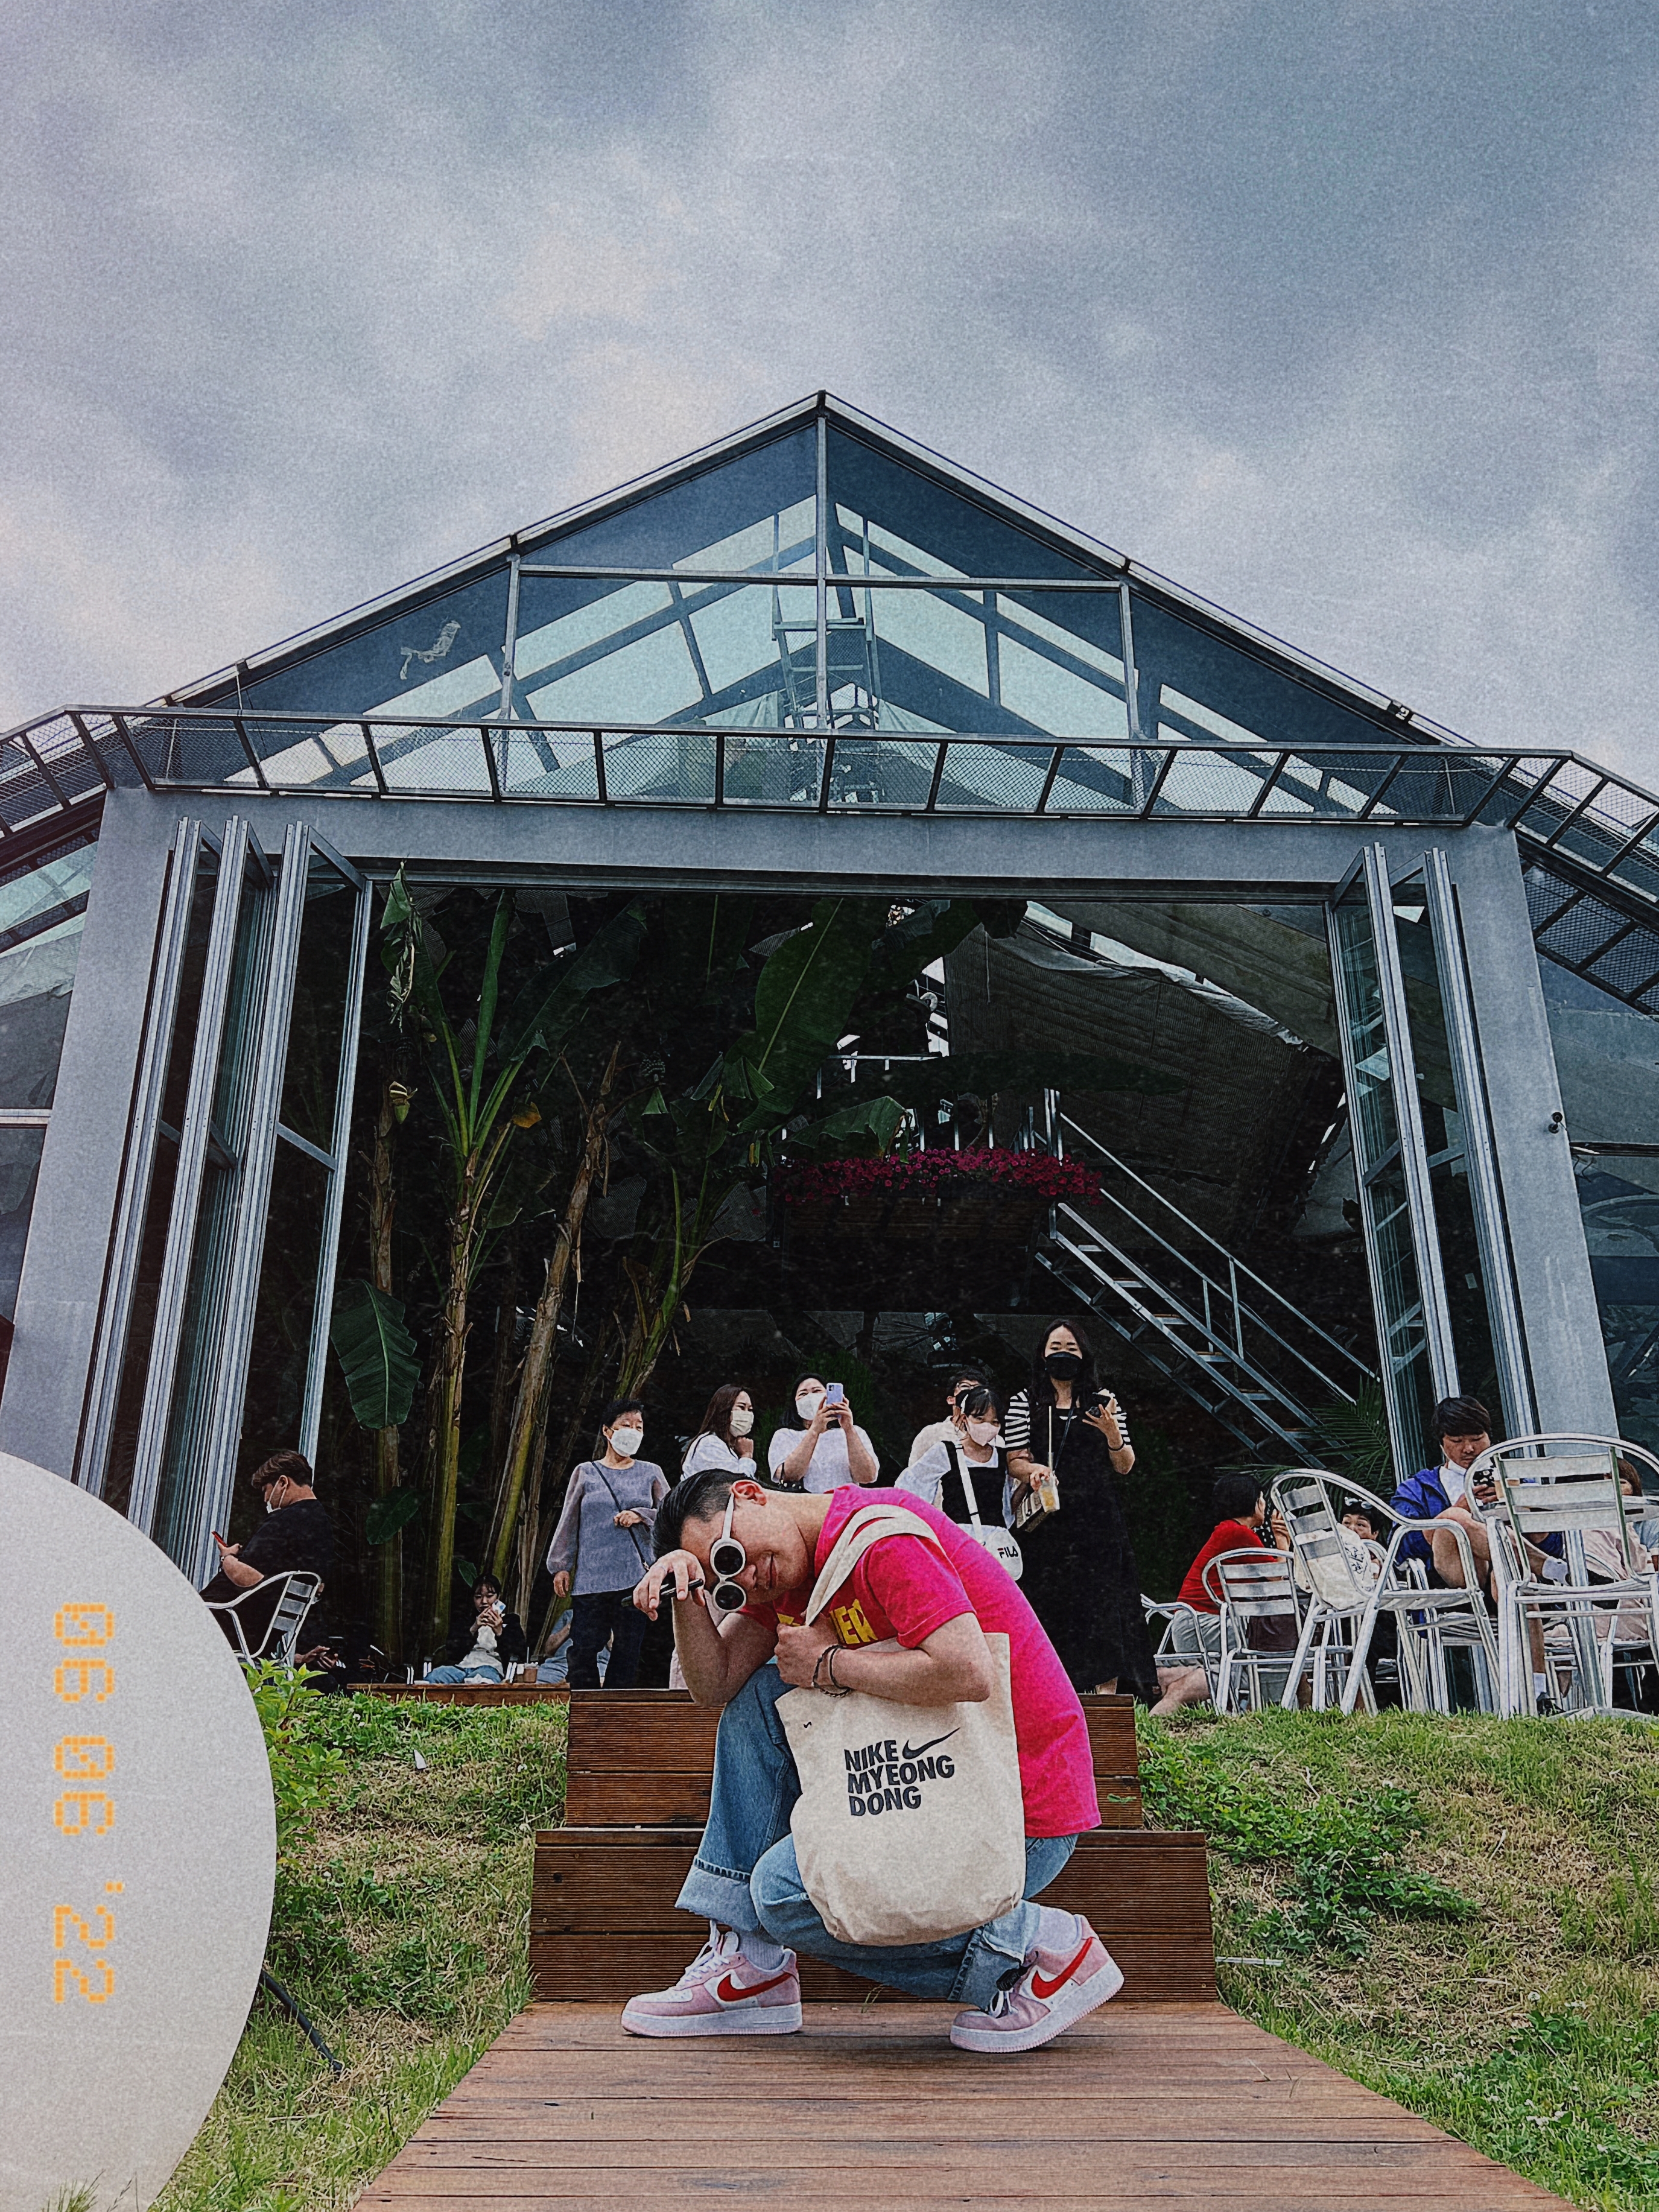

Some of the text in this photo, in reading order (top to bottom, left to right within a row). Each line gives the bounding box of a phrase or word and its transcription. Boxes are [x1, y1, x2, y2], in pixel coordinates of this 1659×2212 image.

[997, 1546, 1019, 1559] FILA
[844, 1740, 899, 1772] NIKE
[848, 1755, 955, 1795] MYEONG
[849, 1786, 922, 1816] DONG
